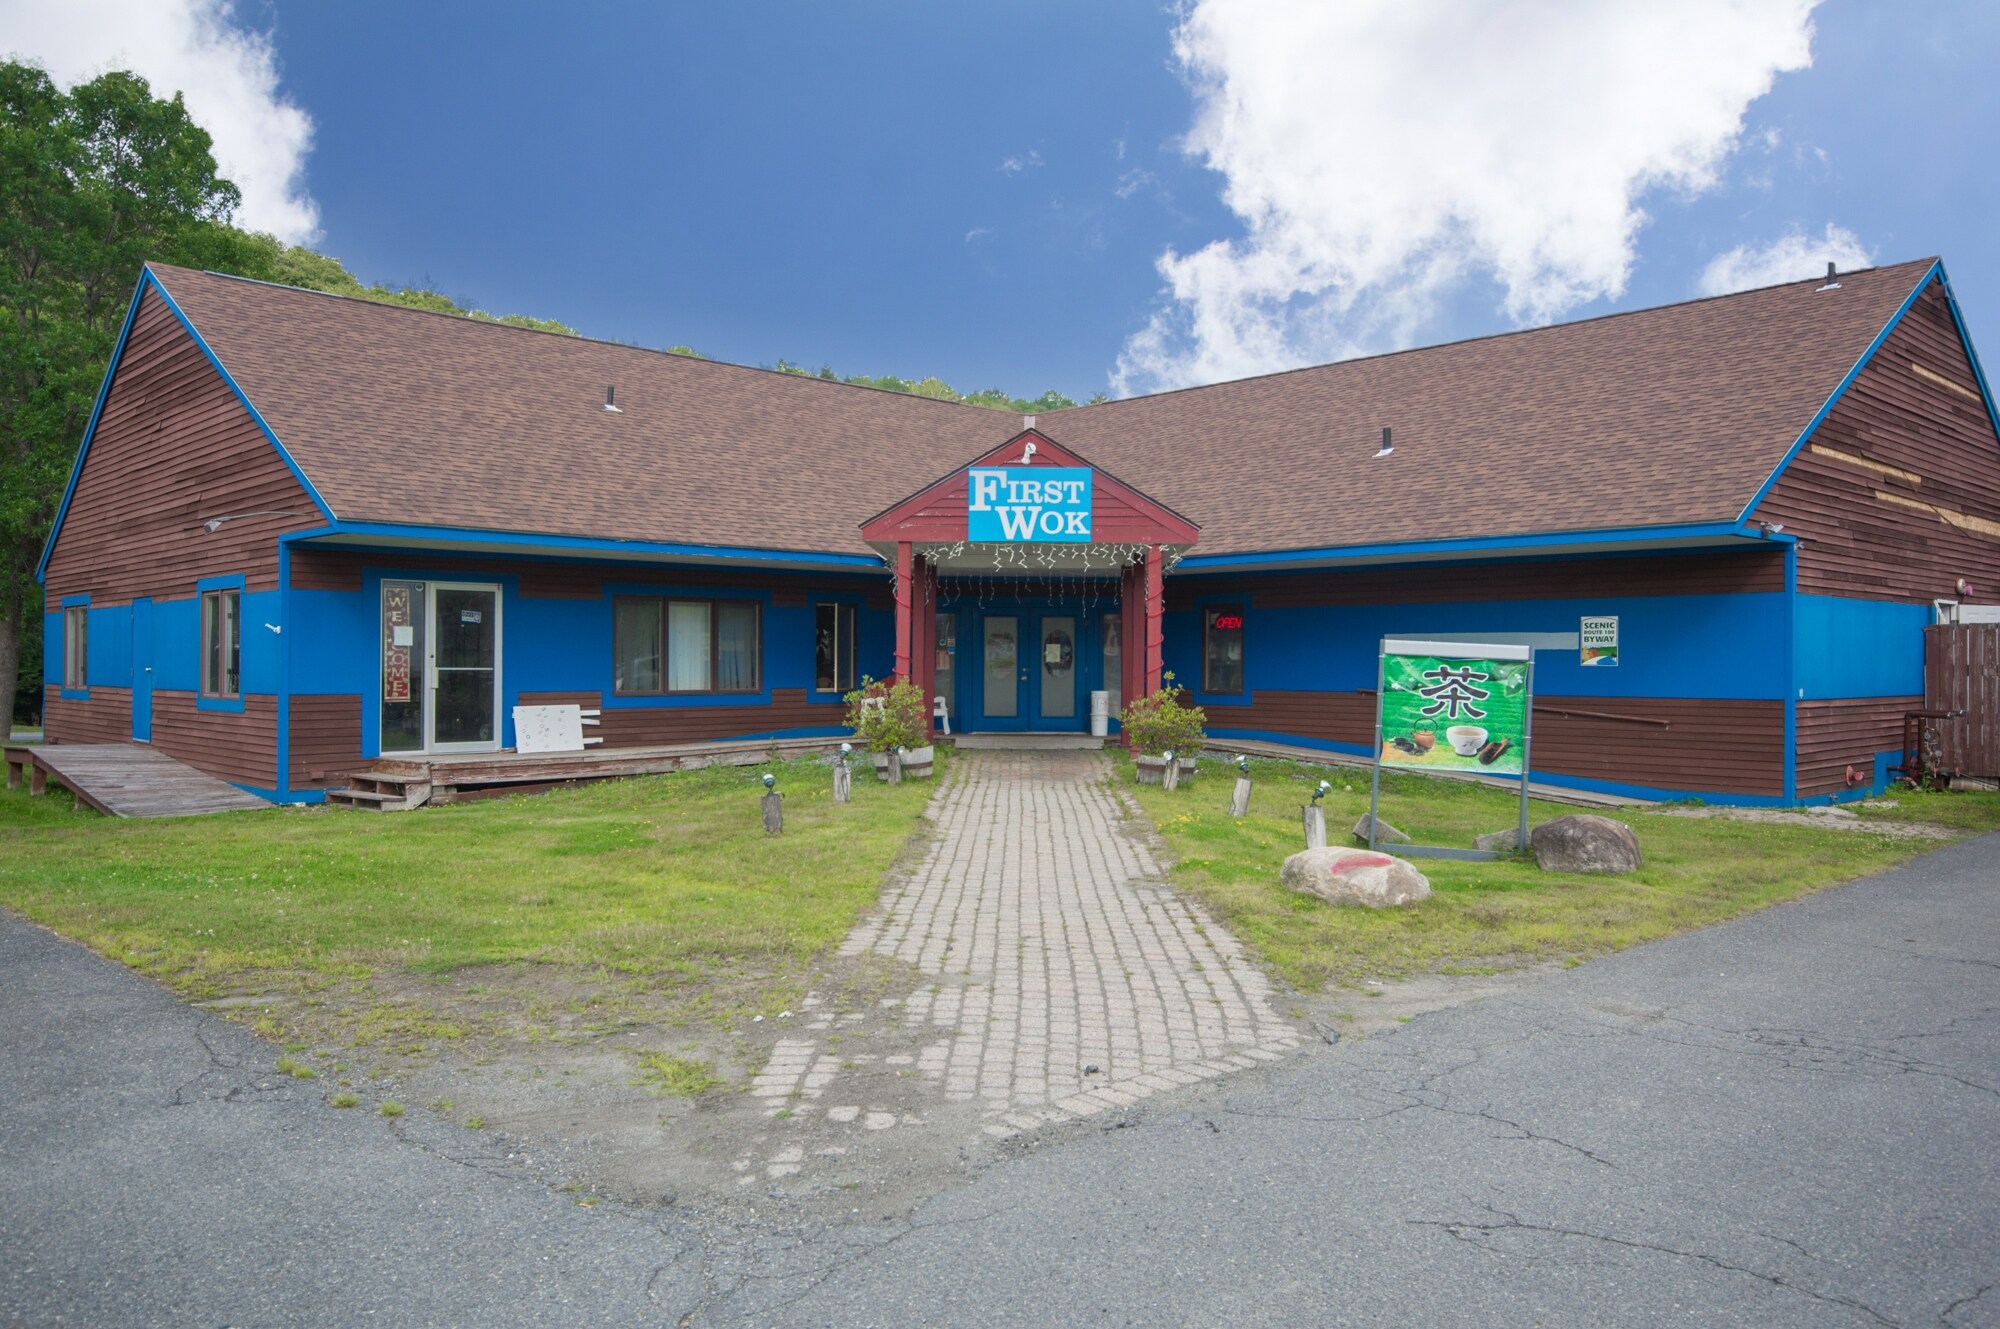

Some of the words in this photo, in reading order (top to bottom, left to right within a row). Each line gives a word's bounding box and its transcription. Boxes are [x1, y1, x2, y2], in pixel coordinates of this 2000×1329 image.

[969, 470, 1084, 511] FIRST
[995, 506, 1090, 540] WOK
[1216, 616, 1243, 629] OPEN
[388, 597, 406, 692] WEOME
[1420, 665, 1490, 719] 茶
